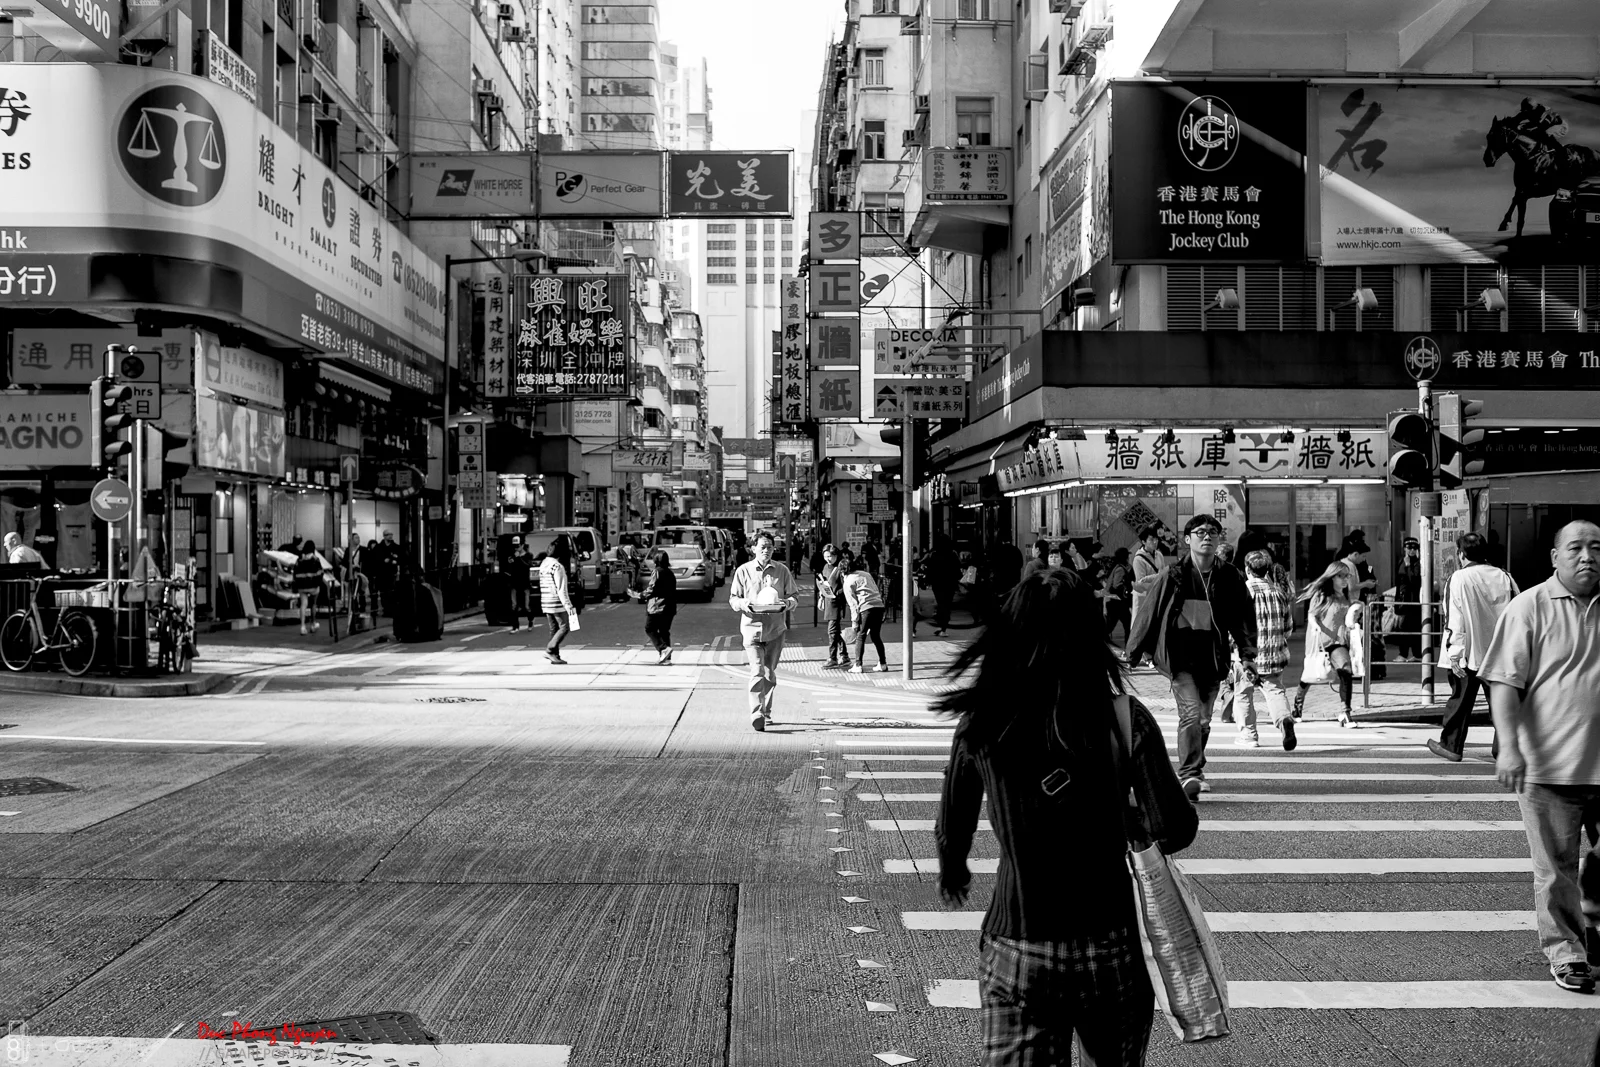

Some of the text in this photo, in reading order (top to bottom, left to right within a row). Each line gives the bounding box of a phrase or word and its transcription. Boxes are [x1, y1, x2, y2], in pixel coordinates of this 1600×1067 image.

[473, 179, 523, 190] WHITE HORSE
[590, 183, 646, 194] Perfect Gear
[1157, 185, 1262, 202] 香港賽馬會
[1159, 209, 1261, 229] The Hong Kong
[258, 190, 294, 228] BRIGHT
[310, 226, 337, 257] SMART
[350, 254, 383, 288] SECURITIES
[1169, 232, 1250, 252] Jockey Club
[1336, 240, 1401, 250] www.hkjc.com
[527, 277, 614, 315] 興旺
[488, 276, 505, 394] 通用建築材料
[517, 317, 624, 348] 麻雀娛樂
[877, 341, 886, 362] 代理
[1452, 350, 1569, 369] 香港賽馬會
[516, 372, 554, 385] 代客泊車
[133, 386, 153, 397] hrs
[119, 400, 150, 415] 全日
[574, 410, 612, 418] 3125 7728
[1105, 434, 1231, 471] 牆紙庫
